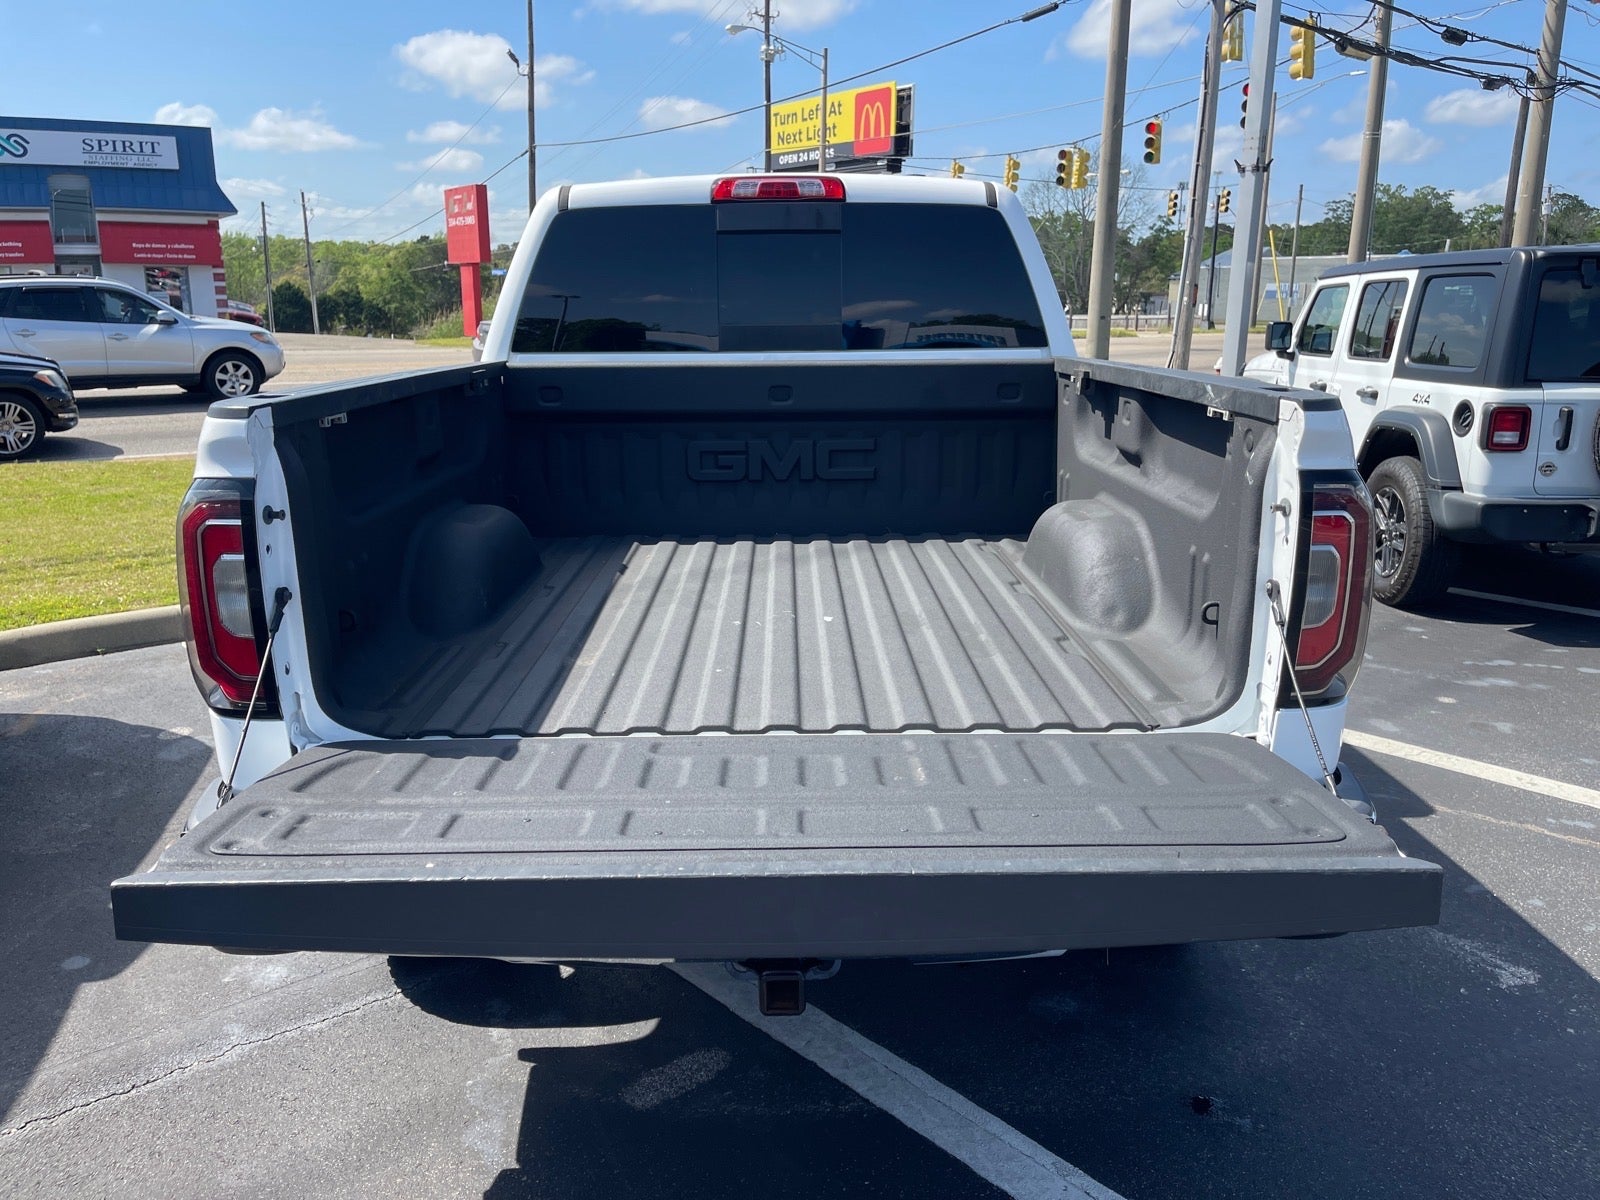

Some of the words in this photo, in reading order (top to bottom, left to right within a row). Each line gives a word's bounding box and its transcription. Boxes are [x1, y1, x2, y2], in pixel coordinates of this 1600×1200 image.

[773, 112, 797, 127] Turn
[801, 103, 822, 122] Lef
[828, 101, 842, 117] At
[82, 138, 160, 153] SPIRIT
[777, 128, 802, 146] Next
[779, 153, 798, 165] OPEN
[799, 151, 808, 162] 24
[686, 439, 877, 482] GMC
